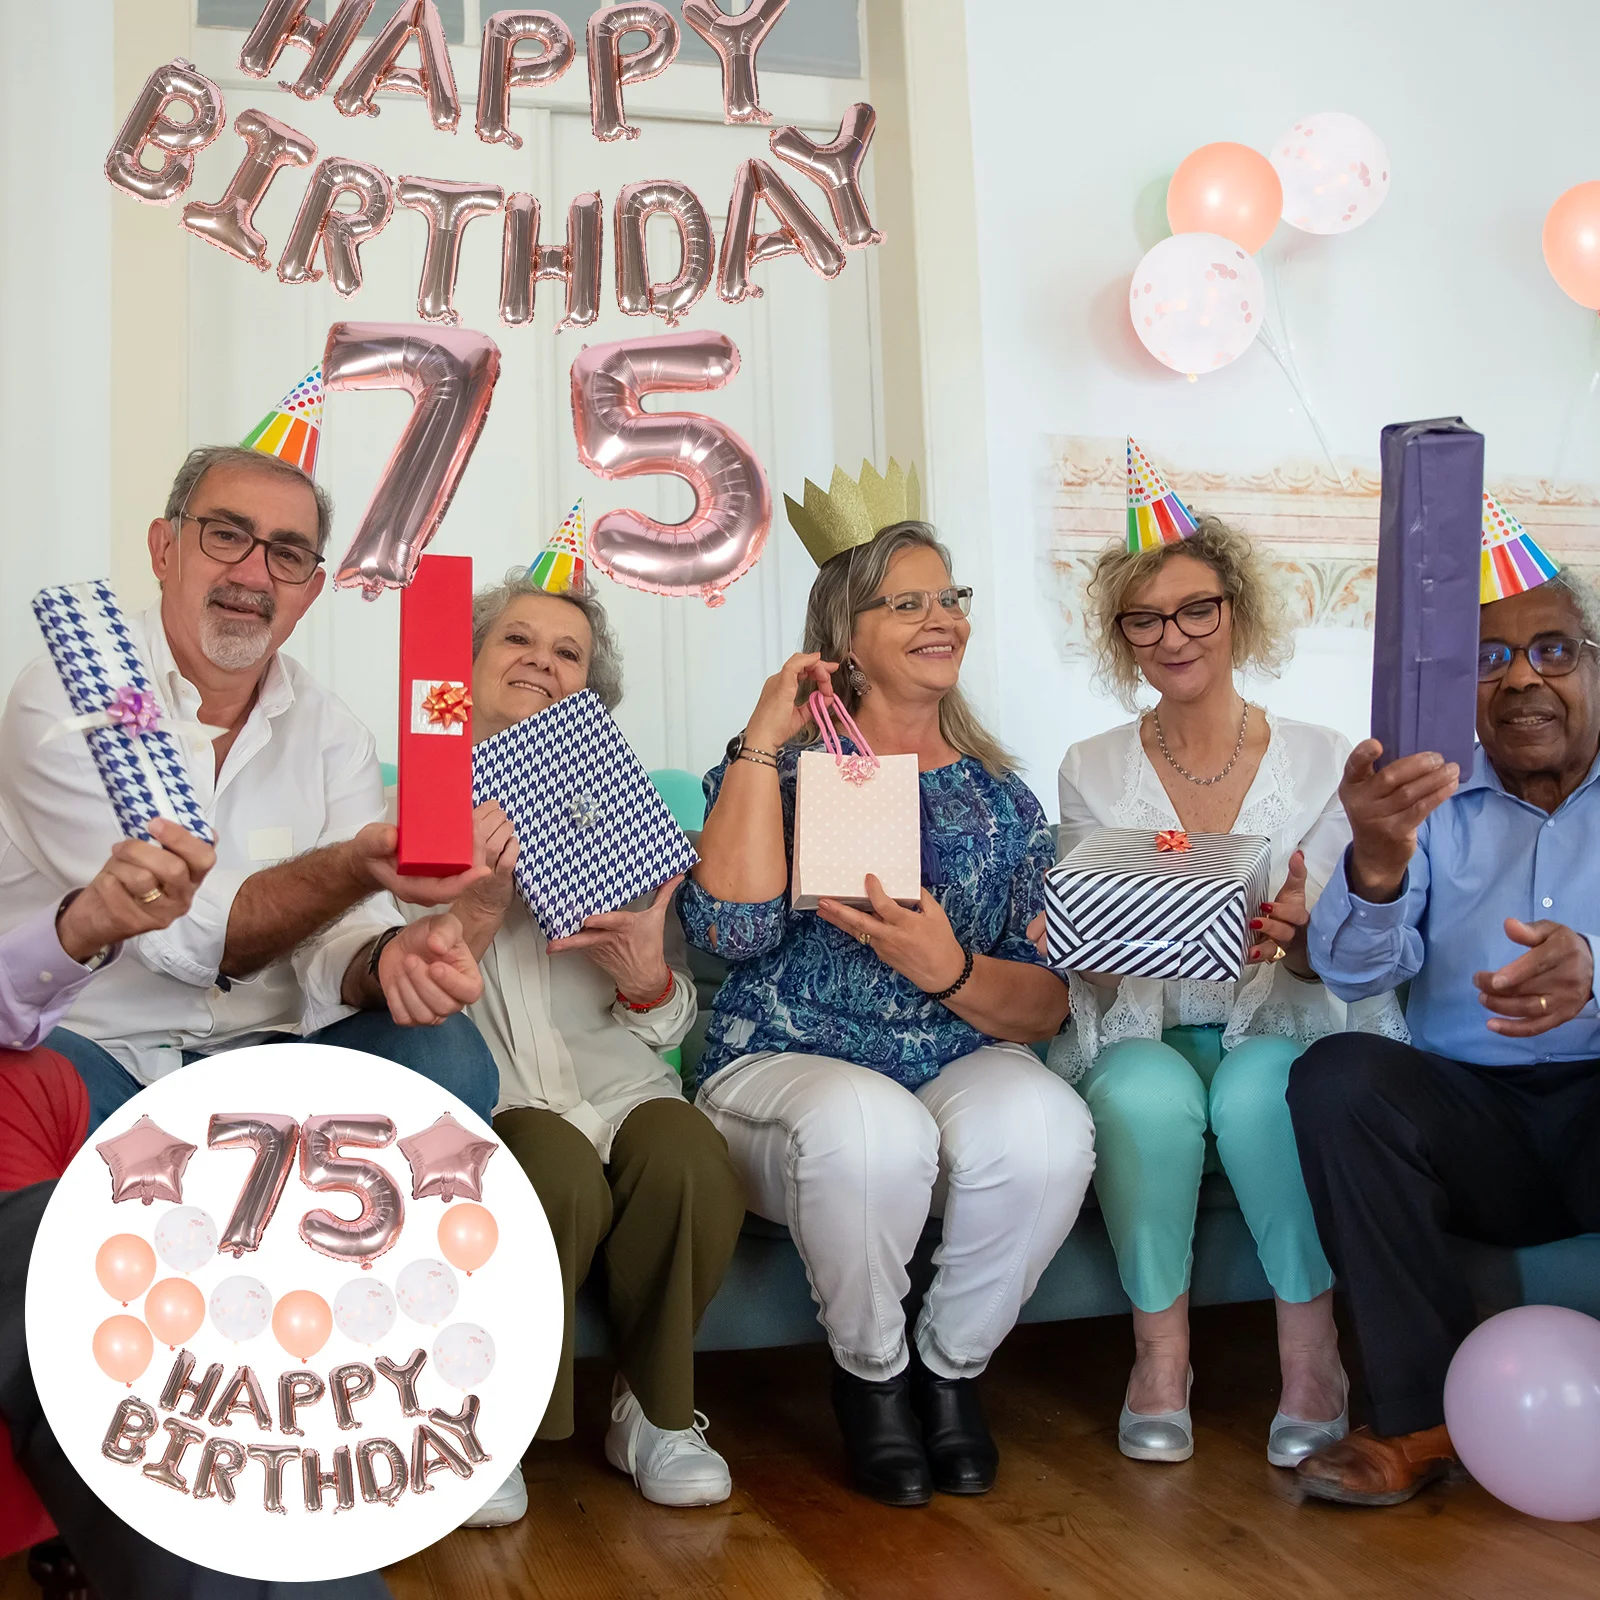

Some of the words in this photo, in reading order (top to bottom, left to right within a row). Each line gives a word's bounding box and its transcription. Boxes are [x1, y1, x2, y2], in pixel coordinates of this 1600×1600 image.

[105, 58, 886, 332] BIRTHDAY
[238, 0, 788, 149] HAPPY
[323, 321, 773, 607] 75
